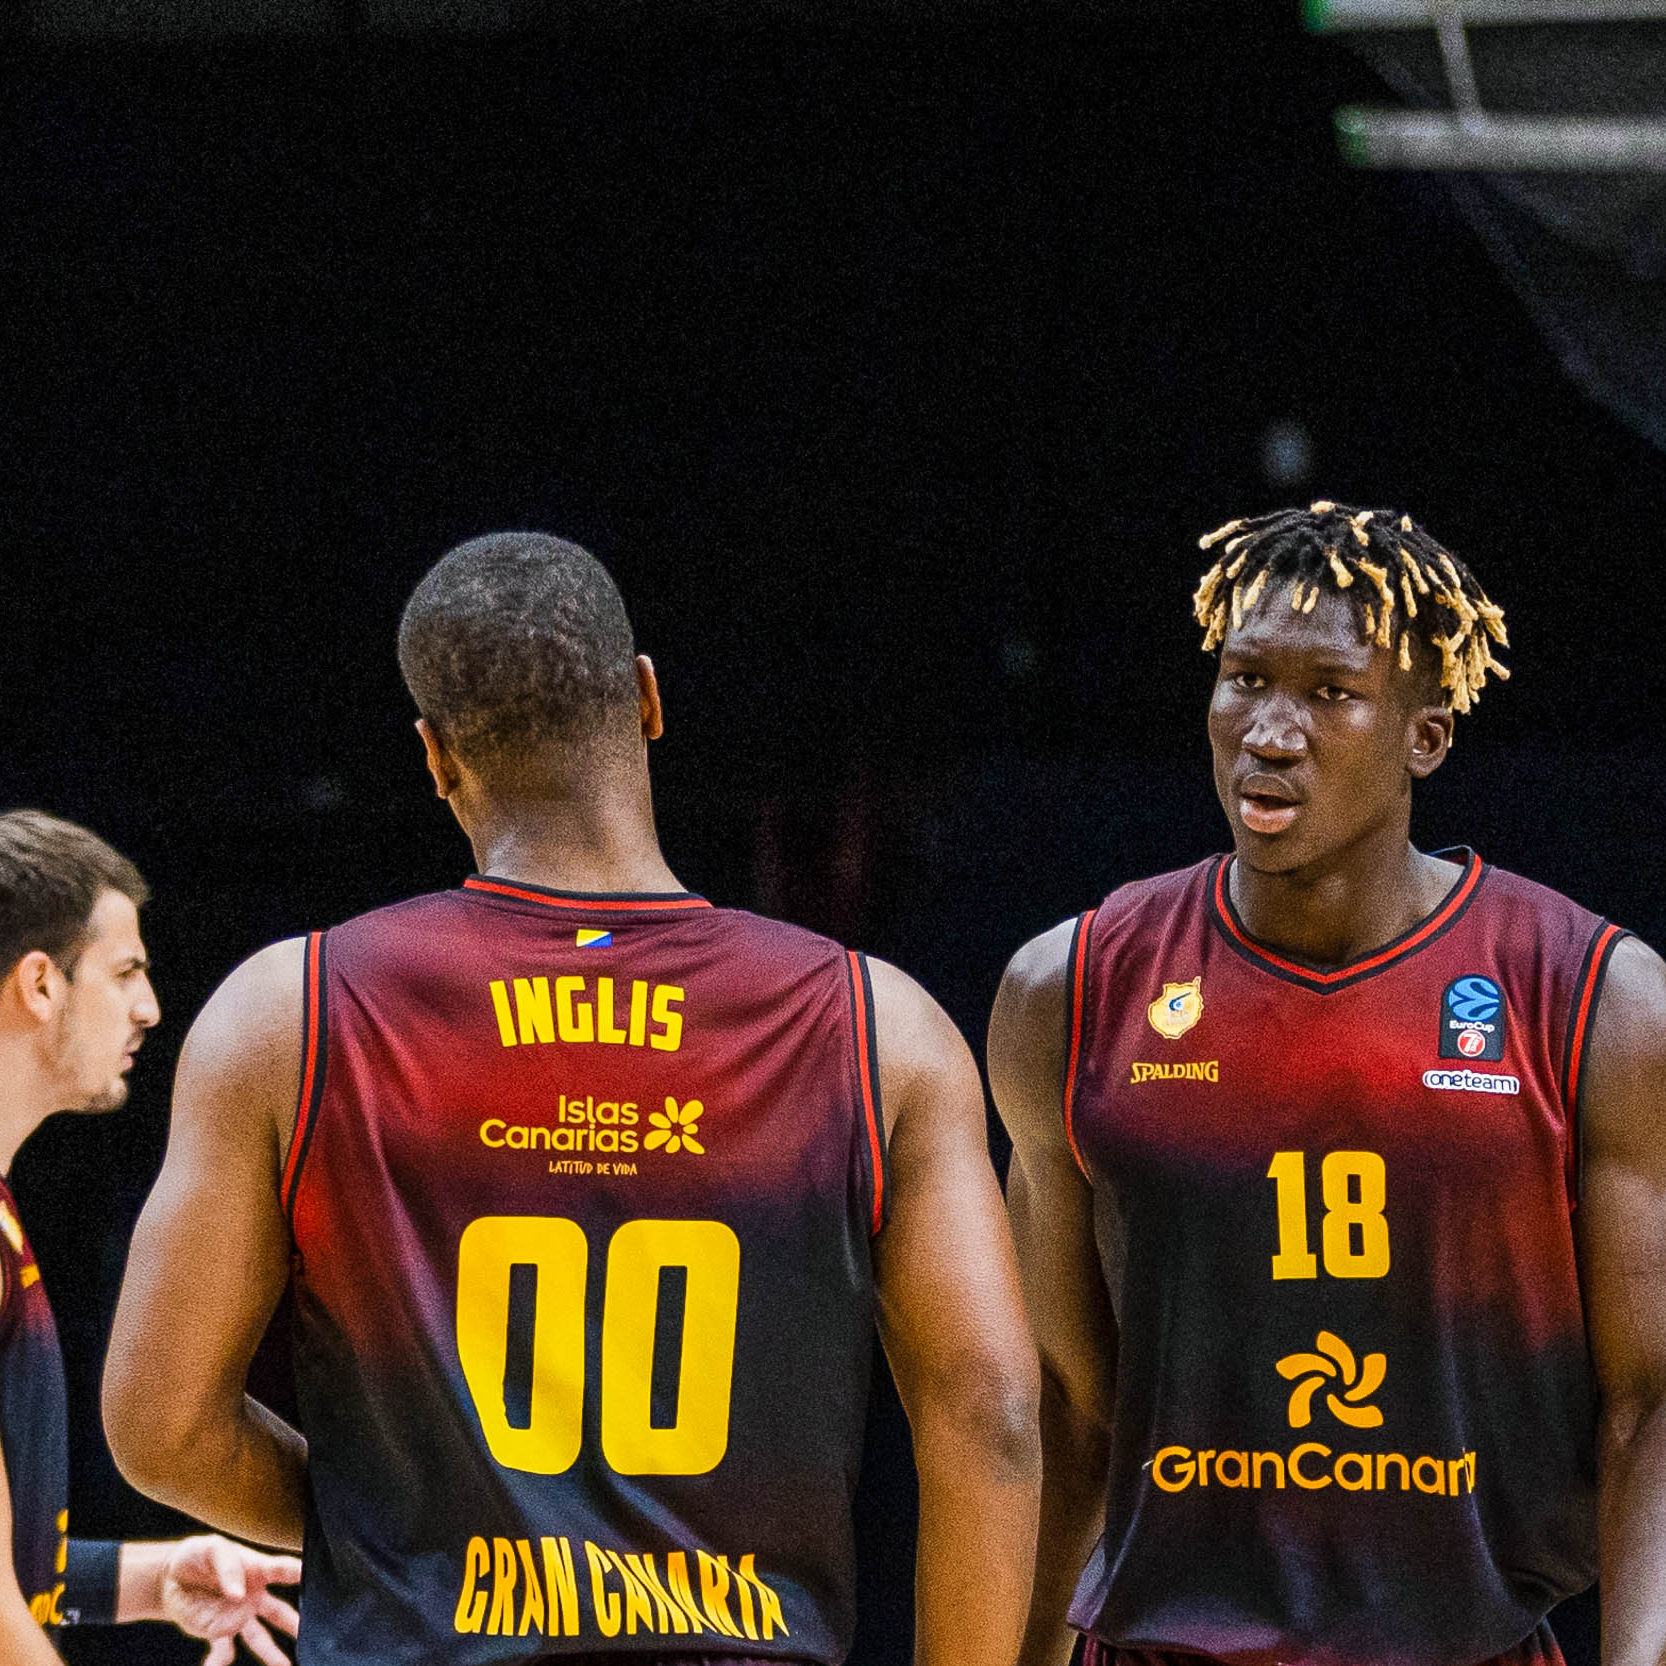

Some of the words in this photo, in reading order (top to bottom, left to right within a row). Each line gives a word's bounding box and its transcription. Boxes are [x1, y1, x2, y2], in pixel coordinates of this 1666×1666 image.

[489, 976, 686, 1052] INGLIS
[1449, 1020, 1495, 1033] EuroCup
[1131, 1060, 1219, 1084] SPALDING
[559, 1095, 639, 1125] Islas
[479, 1119, 639, 1153] Canarias
[596, 1163, 611, 1175] DE
[615, 1163, 638, 1175] VIDA
[1266, 1151, 1391, 1280] 18
[456, 1216, 741, 1476] 00
